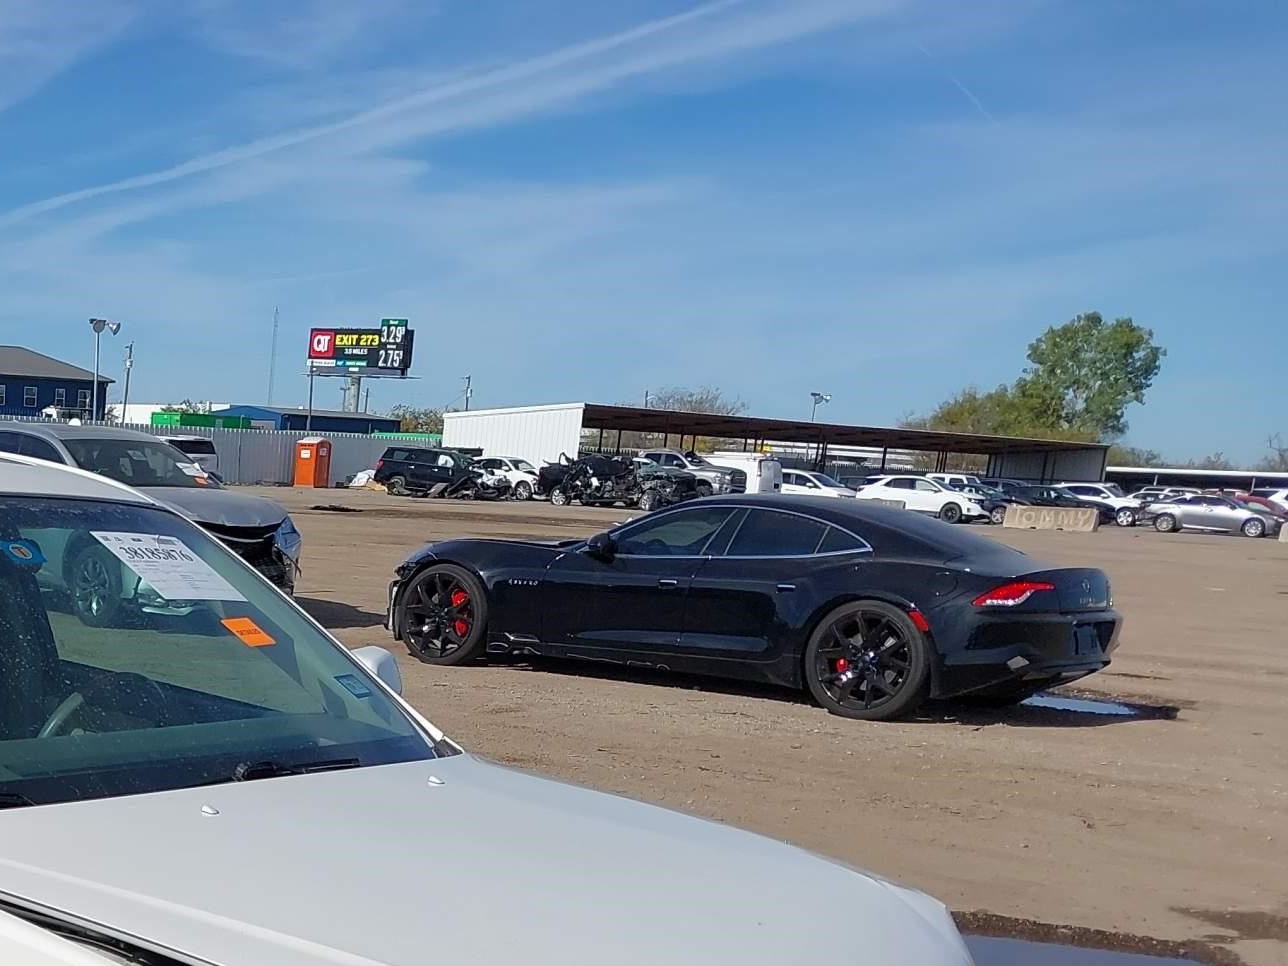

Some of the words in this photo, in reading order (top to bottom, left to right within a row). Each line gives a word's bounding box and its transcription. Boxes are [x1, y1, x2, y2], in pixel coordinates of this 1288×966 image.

[313, 334, 331, 353] QT
[335, 334, 359, 346] EXIT
[359, 334, 379, 346] 273
[119, 546, 194, 562] 38185876
